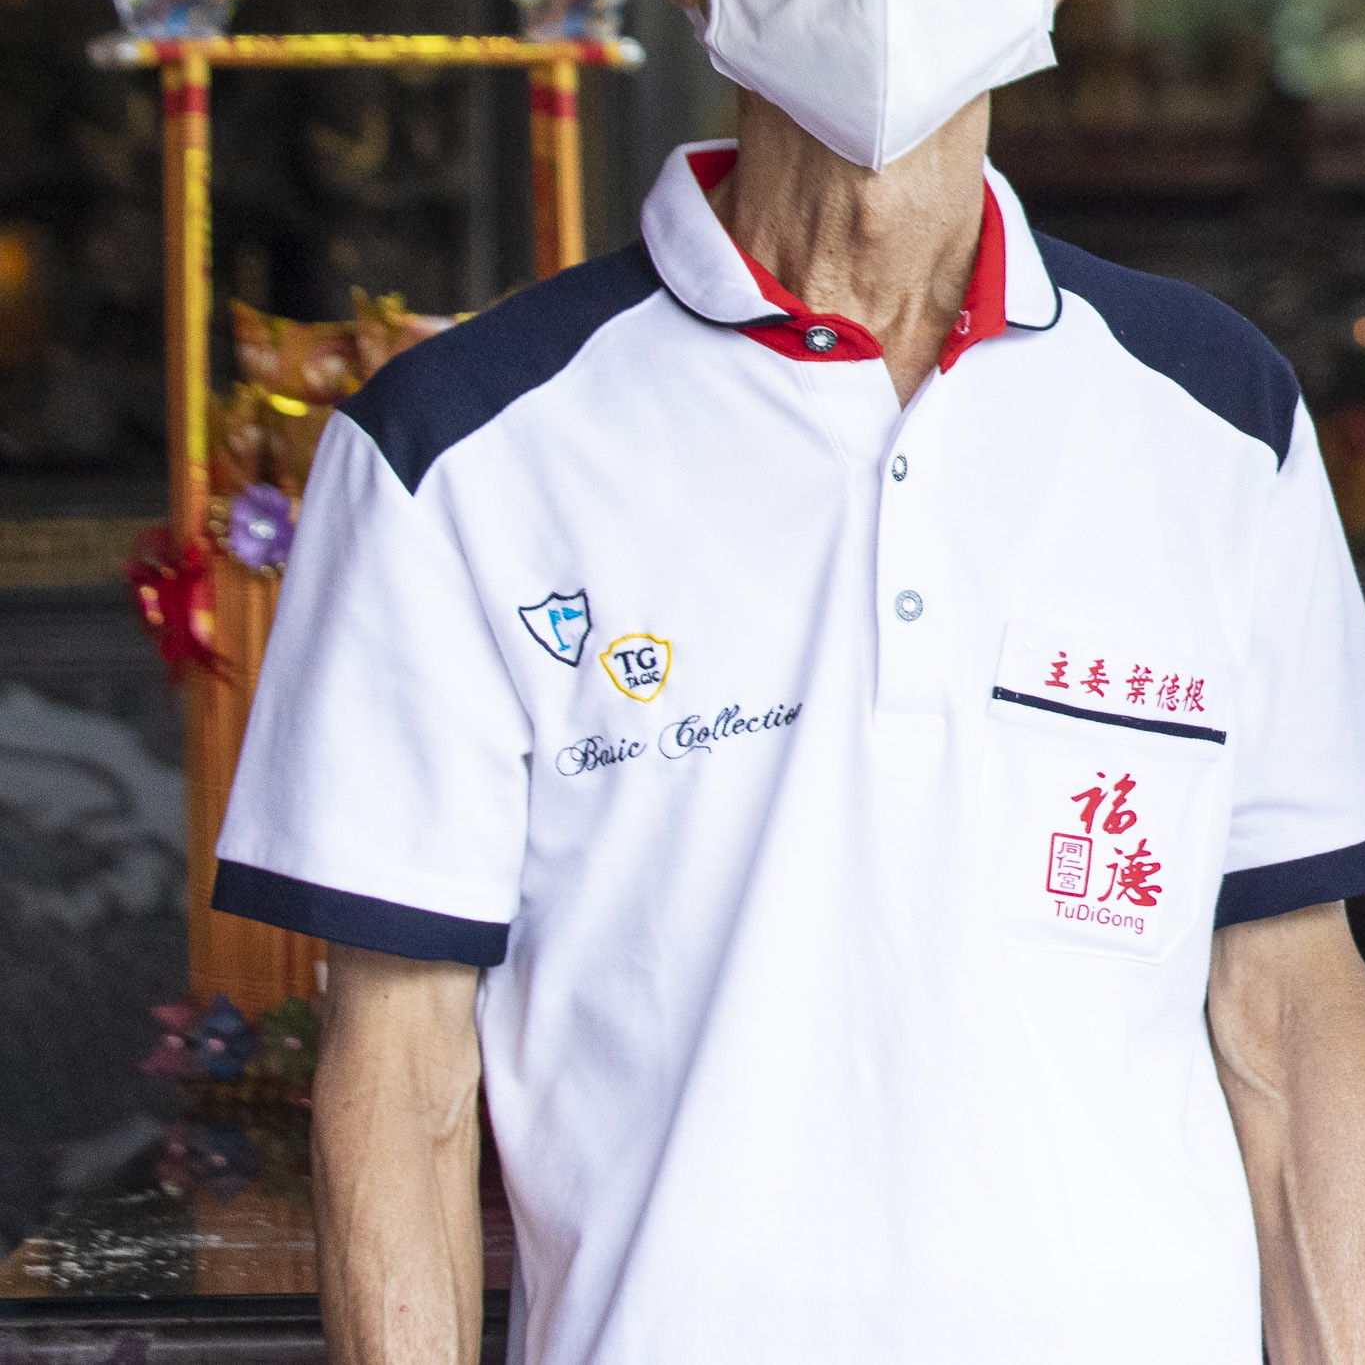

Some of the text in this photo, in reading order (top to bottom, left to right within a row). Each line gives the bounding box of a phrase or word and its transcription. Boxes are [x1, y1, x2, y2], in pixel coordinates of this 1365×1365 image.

[614, 646, 657, 675] TG
[1045, 650, 1110, 698] 主委
[555, 735, 648, 776] Basic
[1070, 771, 1163, 907] 福德
[1054, 899, 1145, 935] TuDiGong
